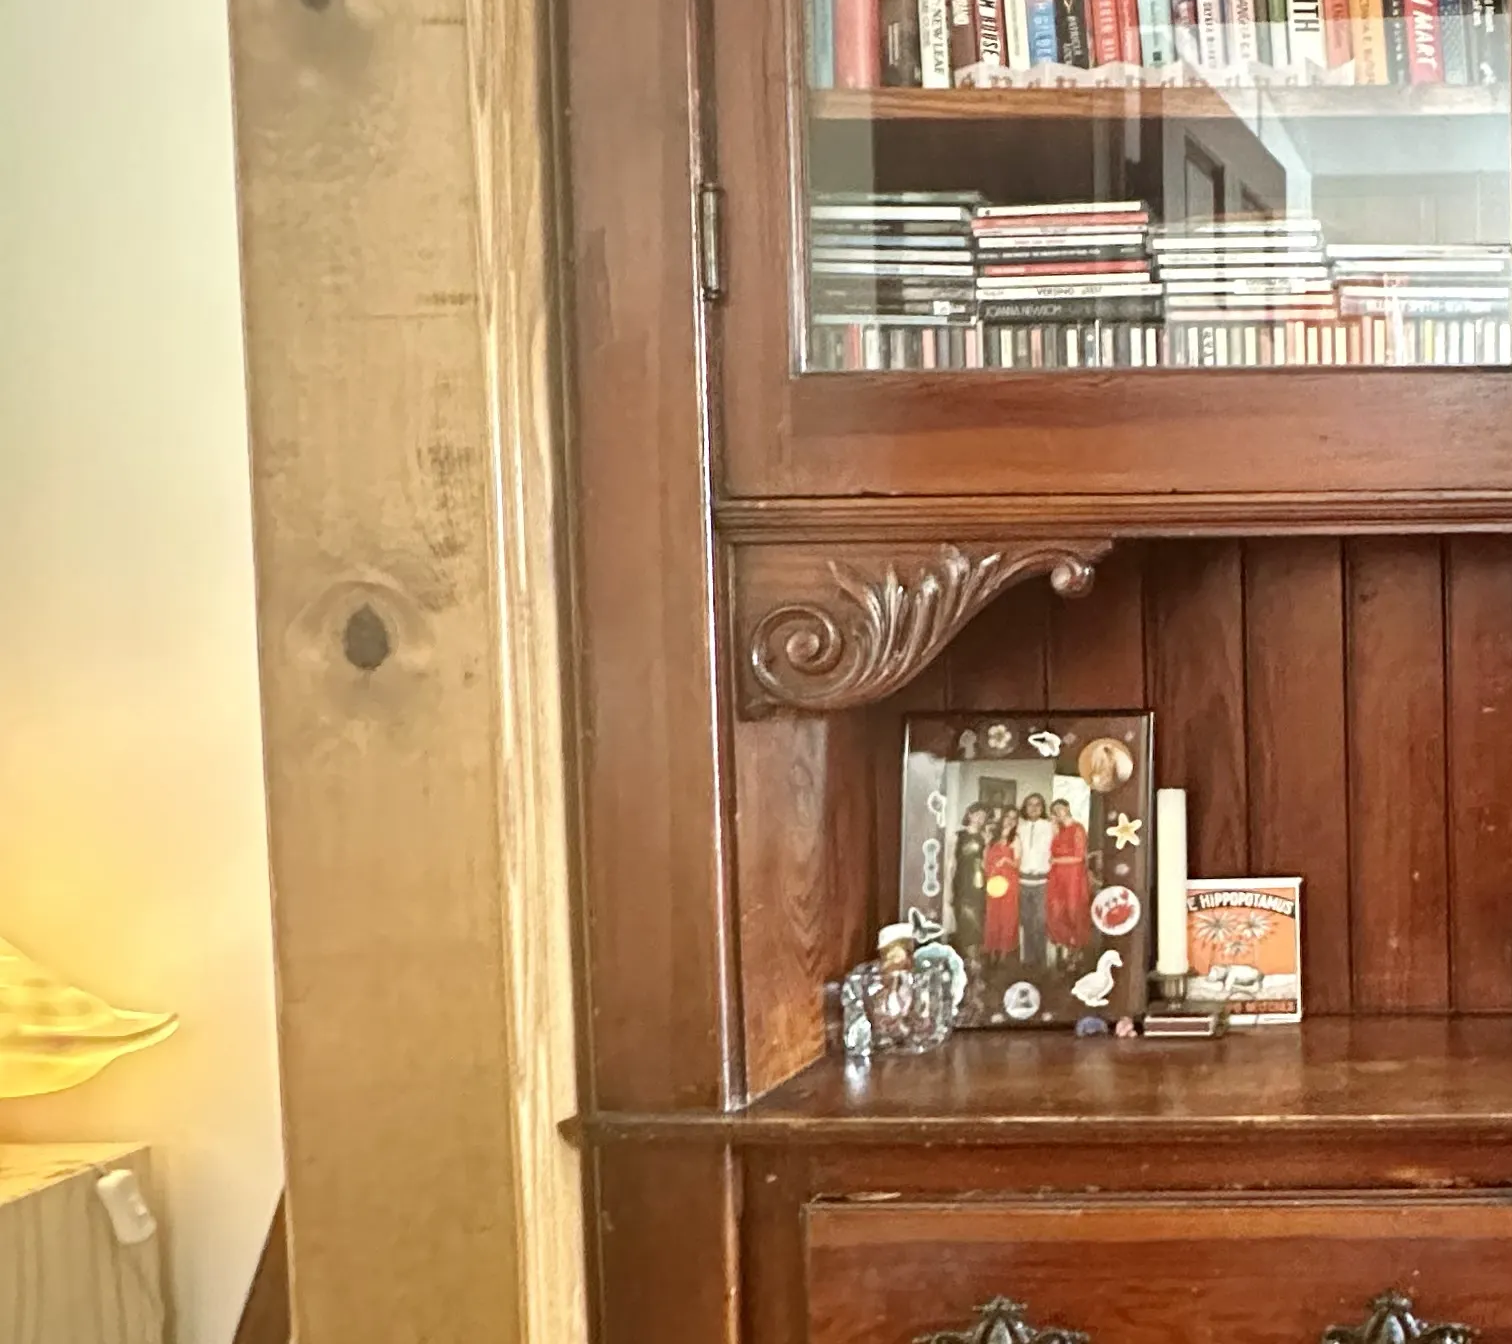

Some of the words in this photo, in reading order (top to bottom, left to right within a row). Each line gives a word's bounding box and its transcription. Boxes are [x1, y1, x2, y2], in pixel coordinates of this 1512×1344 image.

[931, 8, 944, 41] NEW
[981, 15, 1000, 56] HOUSE
[1413, 10, 1438, 72] MART
[933, 43, 947, 76] LEAF
[1200, 891, 1294, 915] HIPPOPOTAMUS
